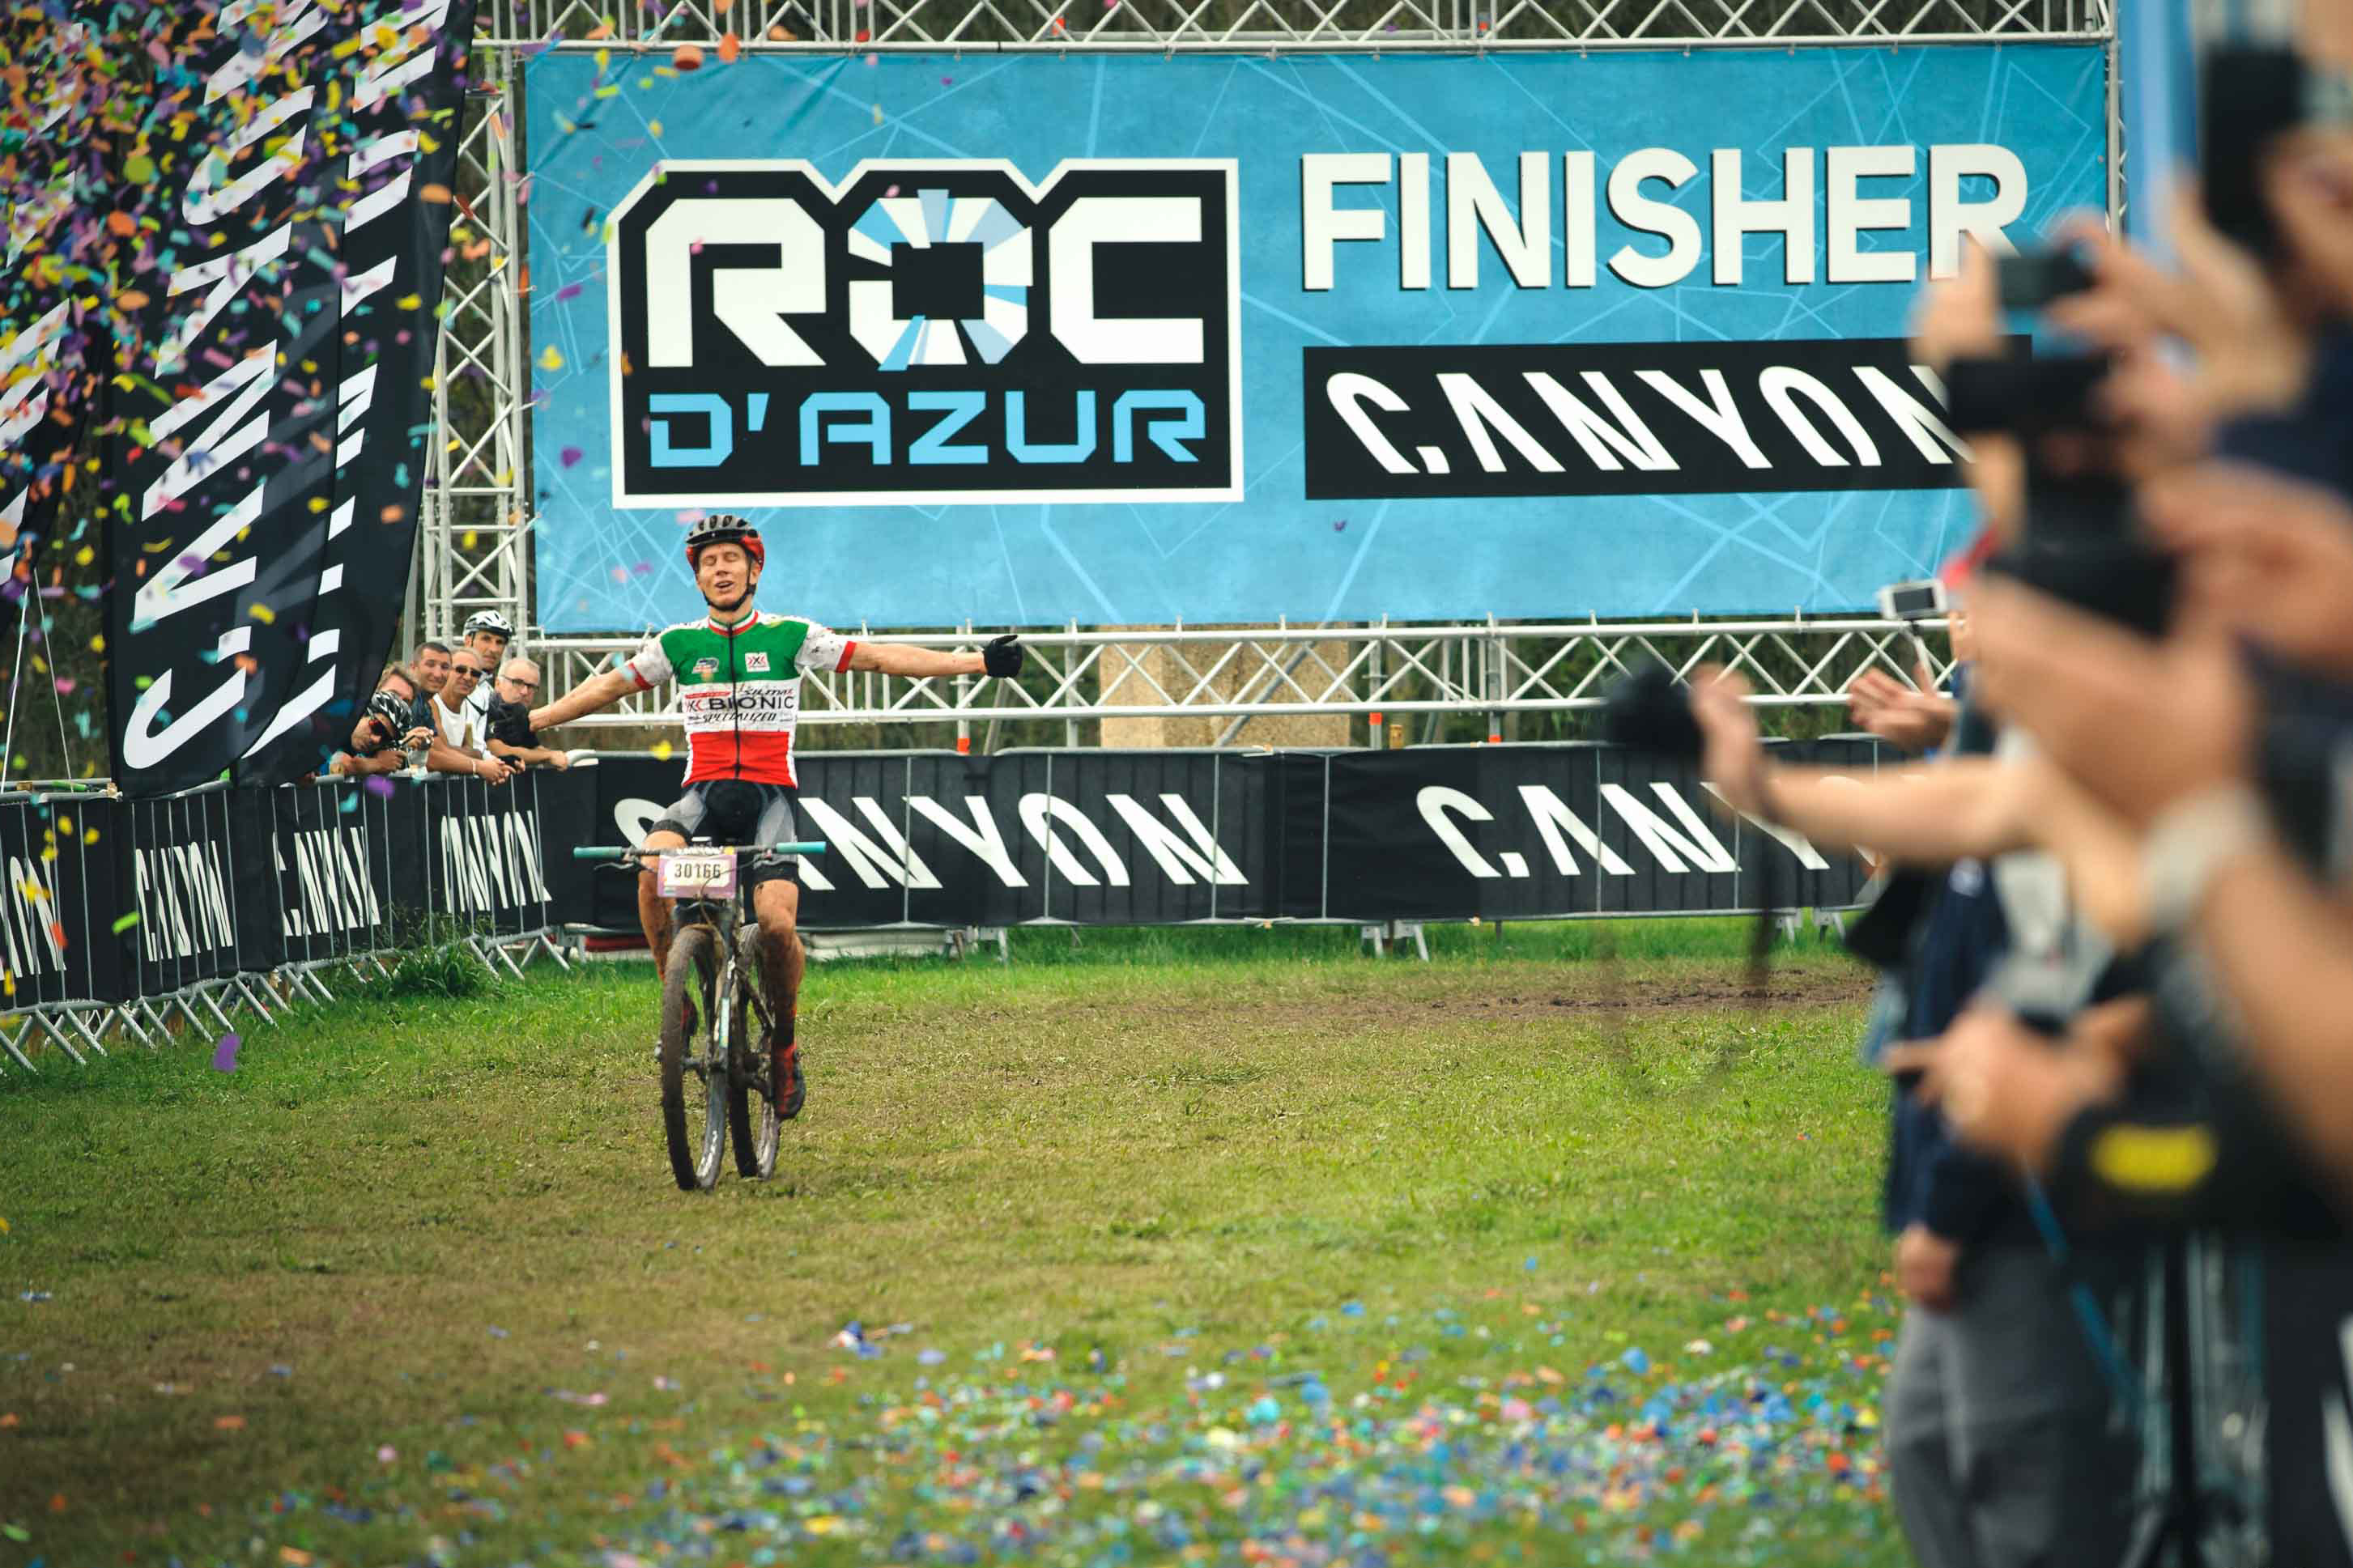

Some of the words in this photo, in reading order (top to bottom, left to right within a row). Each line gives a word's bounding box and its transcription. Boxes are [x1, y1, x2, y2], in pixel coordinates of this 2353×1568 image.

[1302, 144, 2028, 291] FINISHER
[645, 188, 1205, 372] ROC
[649, 389, 1206, 468] D'AZUR
[1325, 365, 1977, 474] CANYON
[708, 696, 794, 710] BIONIC
[613, 792, 1250, 890] NYON
[1416, 781, 1879, 878] CAN
